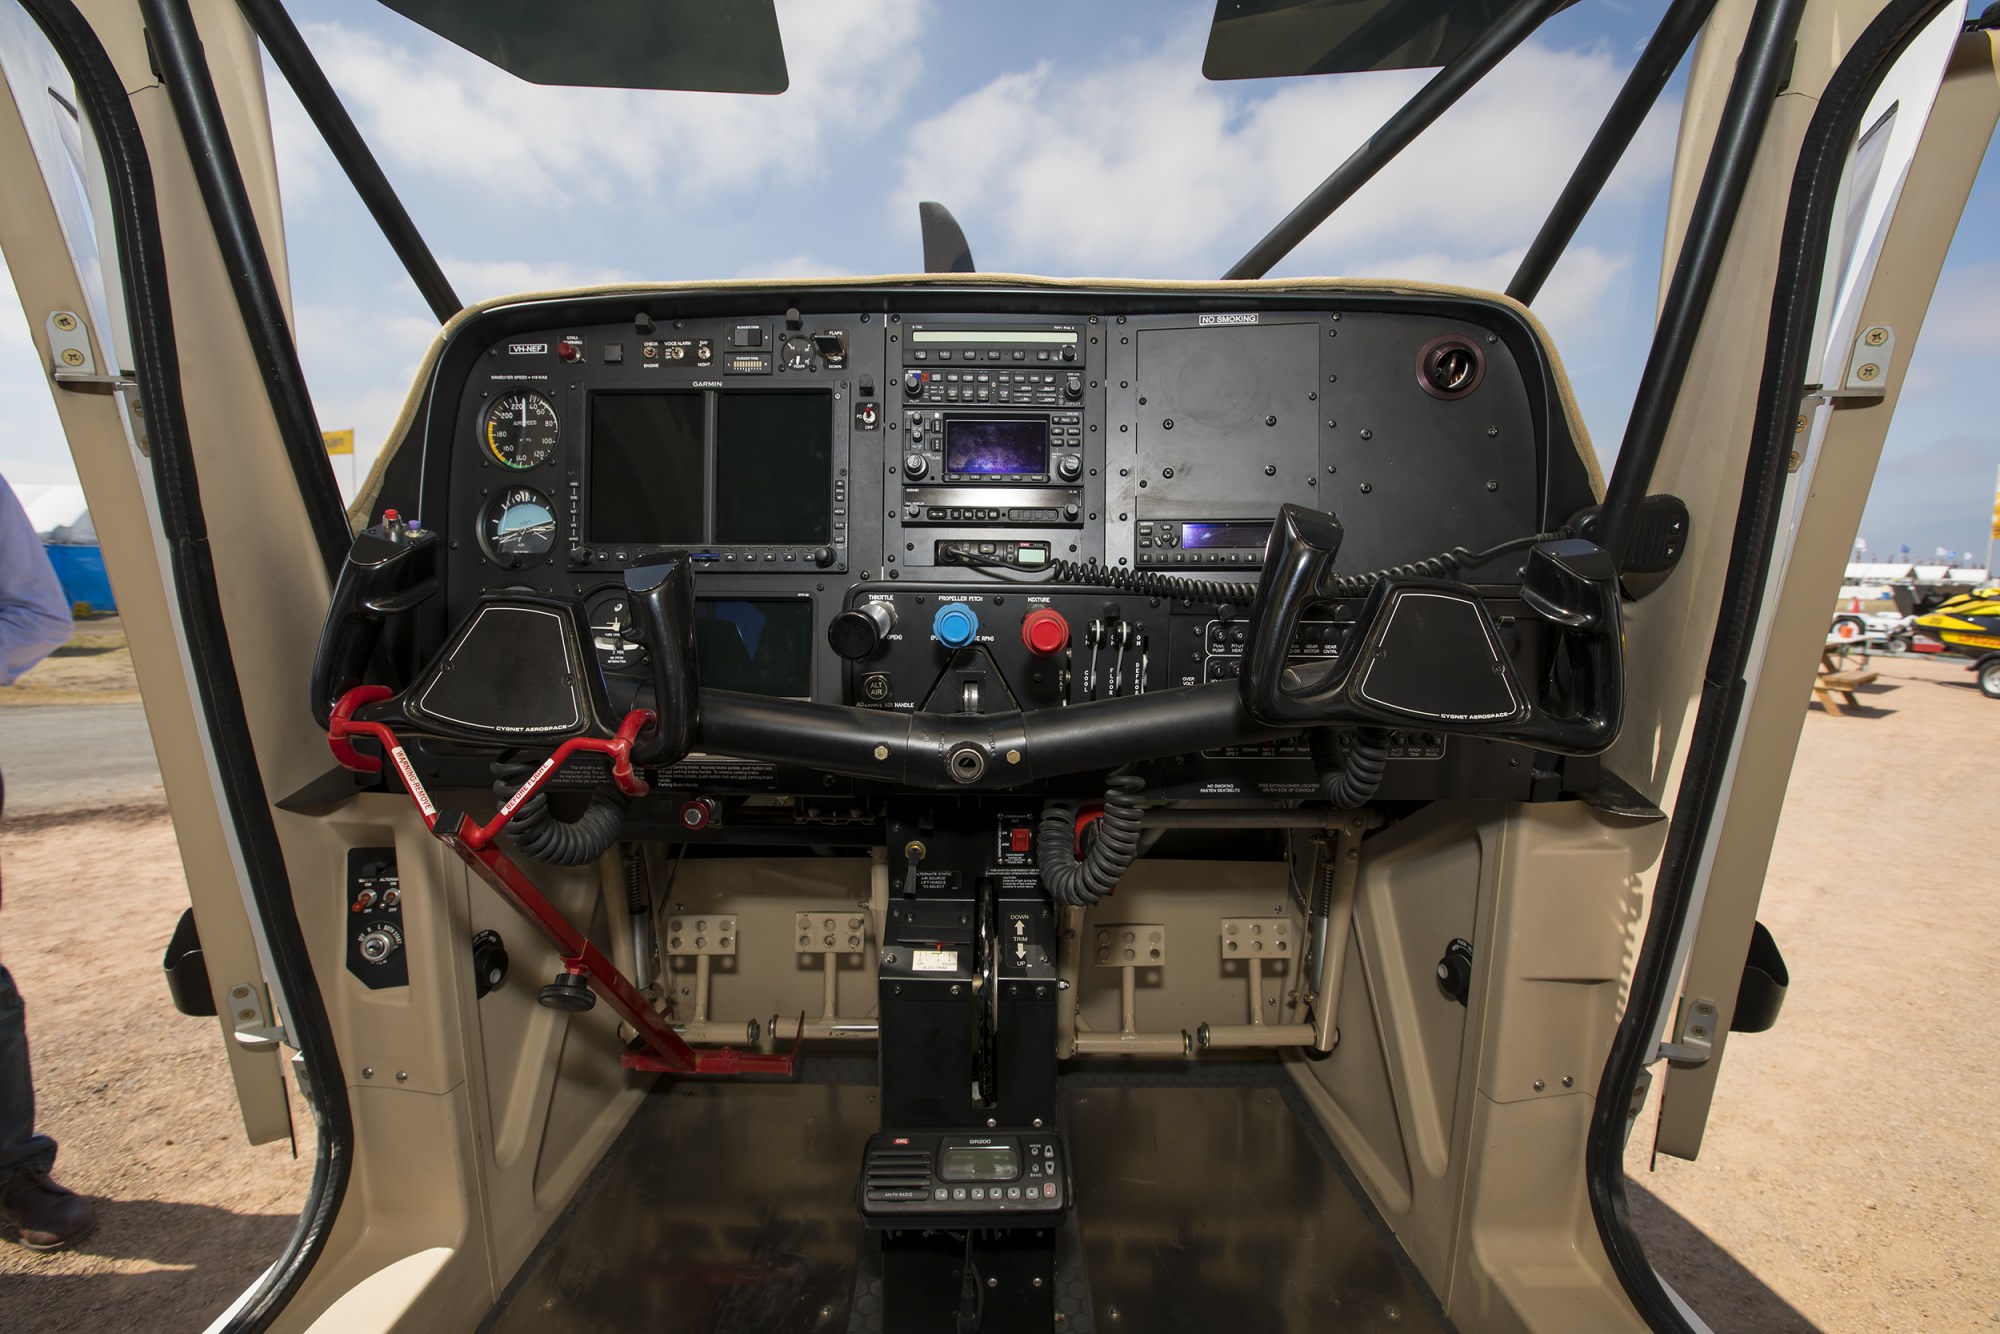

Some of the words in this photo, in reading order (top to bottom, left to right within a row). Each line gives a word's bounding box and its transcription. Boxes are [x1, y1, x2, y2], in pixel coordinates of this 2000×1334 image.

[1136, 635, 1141, 646] ON
[525, 724, 567, 732] AEROSPACE
[396, 750, 432, 810] WARNING-REMOVE
[505, 784, 529, 810] BEFORE
[384, 925, 395, 934] BOTH
[393, 931, 402, 944] START
